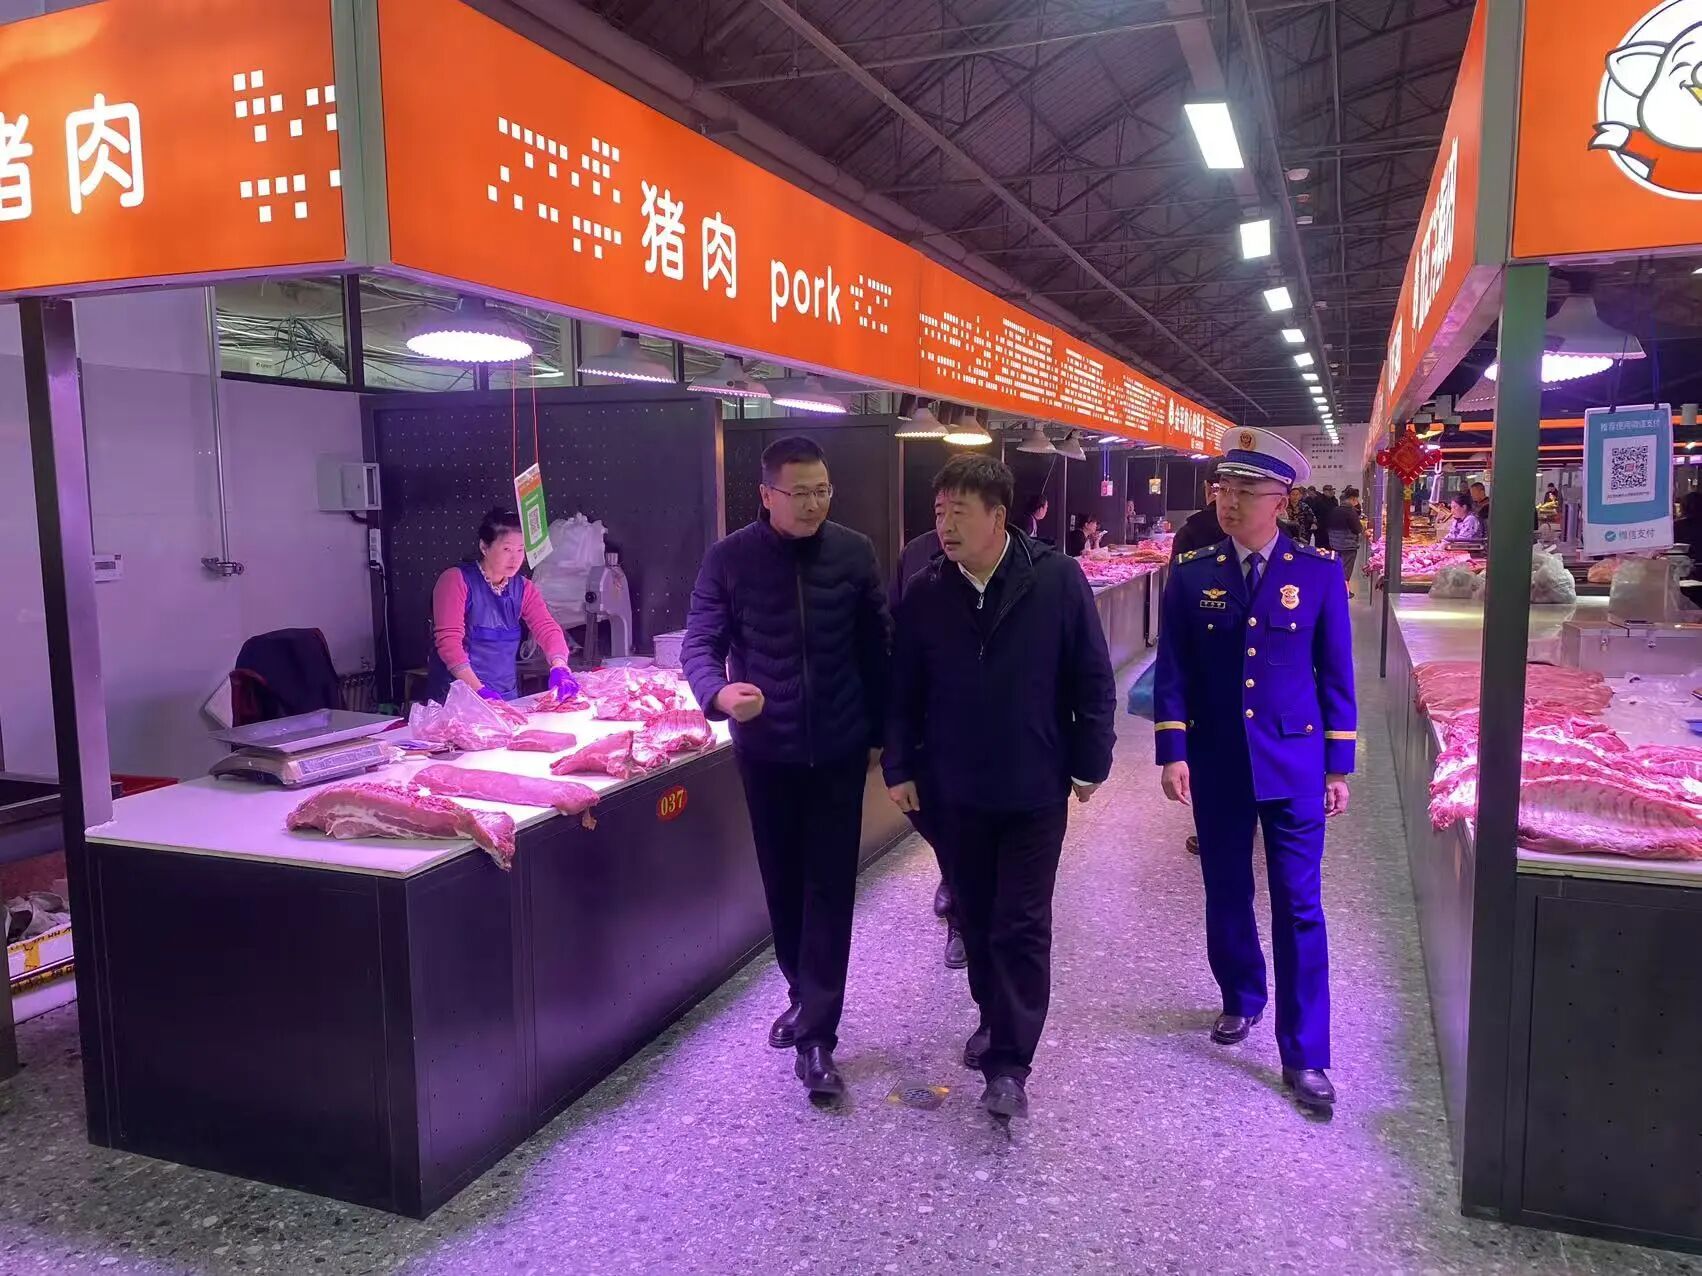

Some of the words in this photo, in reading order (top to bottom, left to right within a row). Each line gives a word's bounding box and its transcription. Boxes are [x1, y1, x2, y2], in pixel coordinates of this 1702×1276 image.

[641, 180, 737, 298] 猪肉
[771, 259, 841, 325] pork
[1619, 528, 1656, 541] 微信支付
[661, 789, 684, 816] 037
